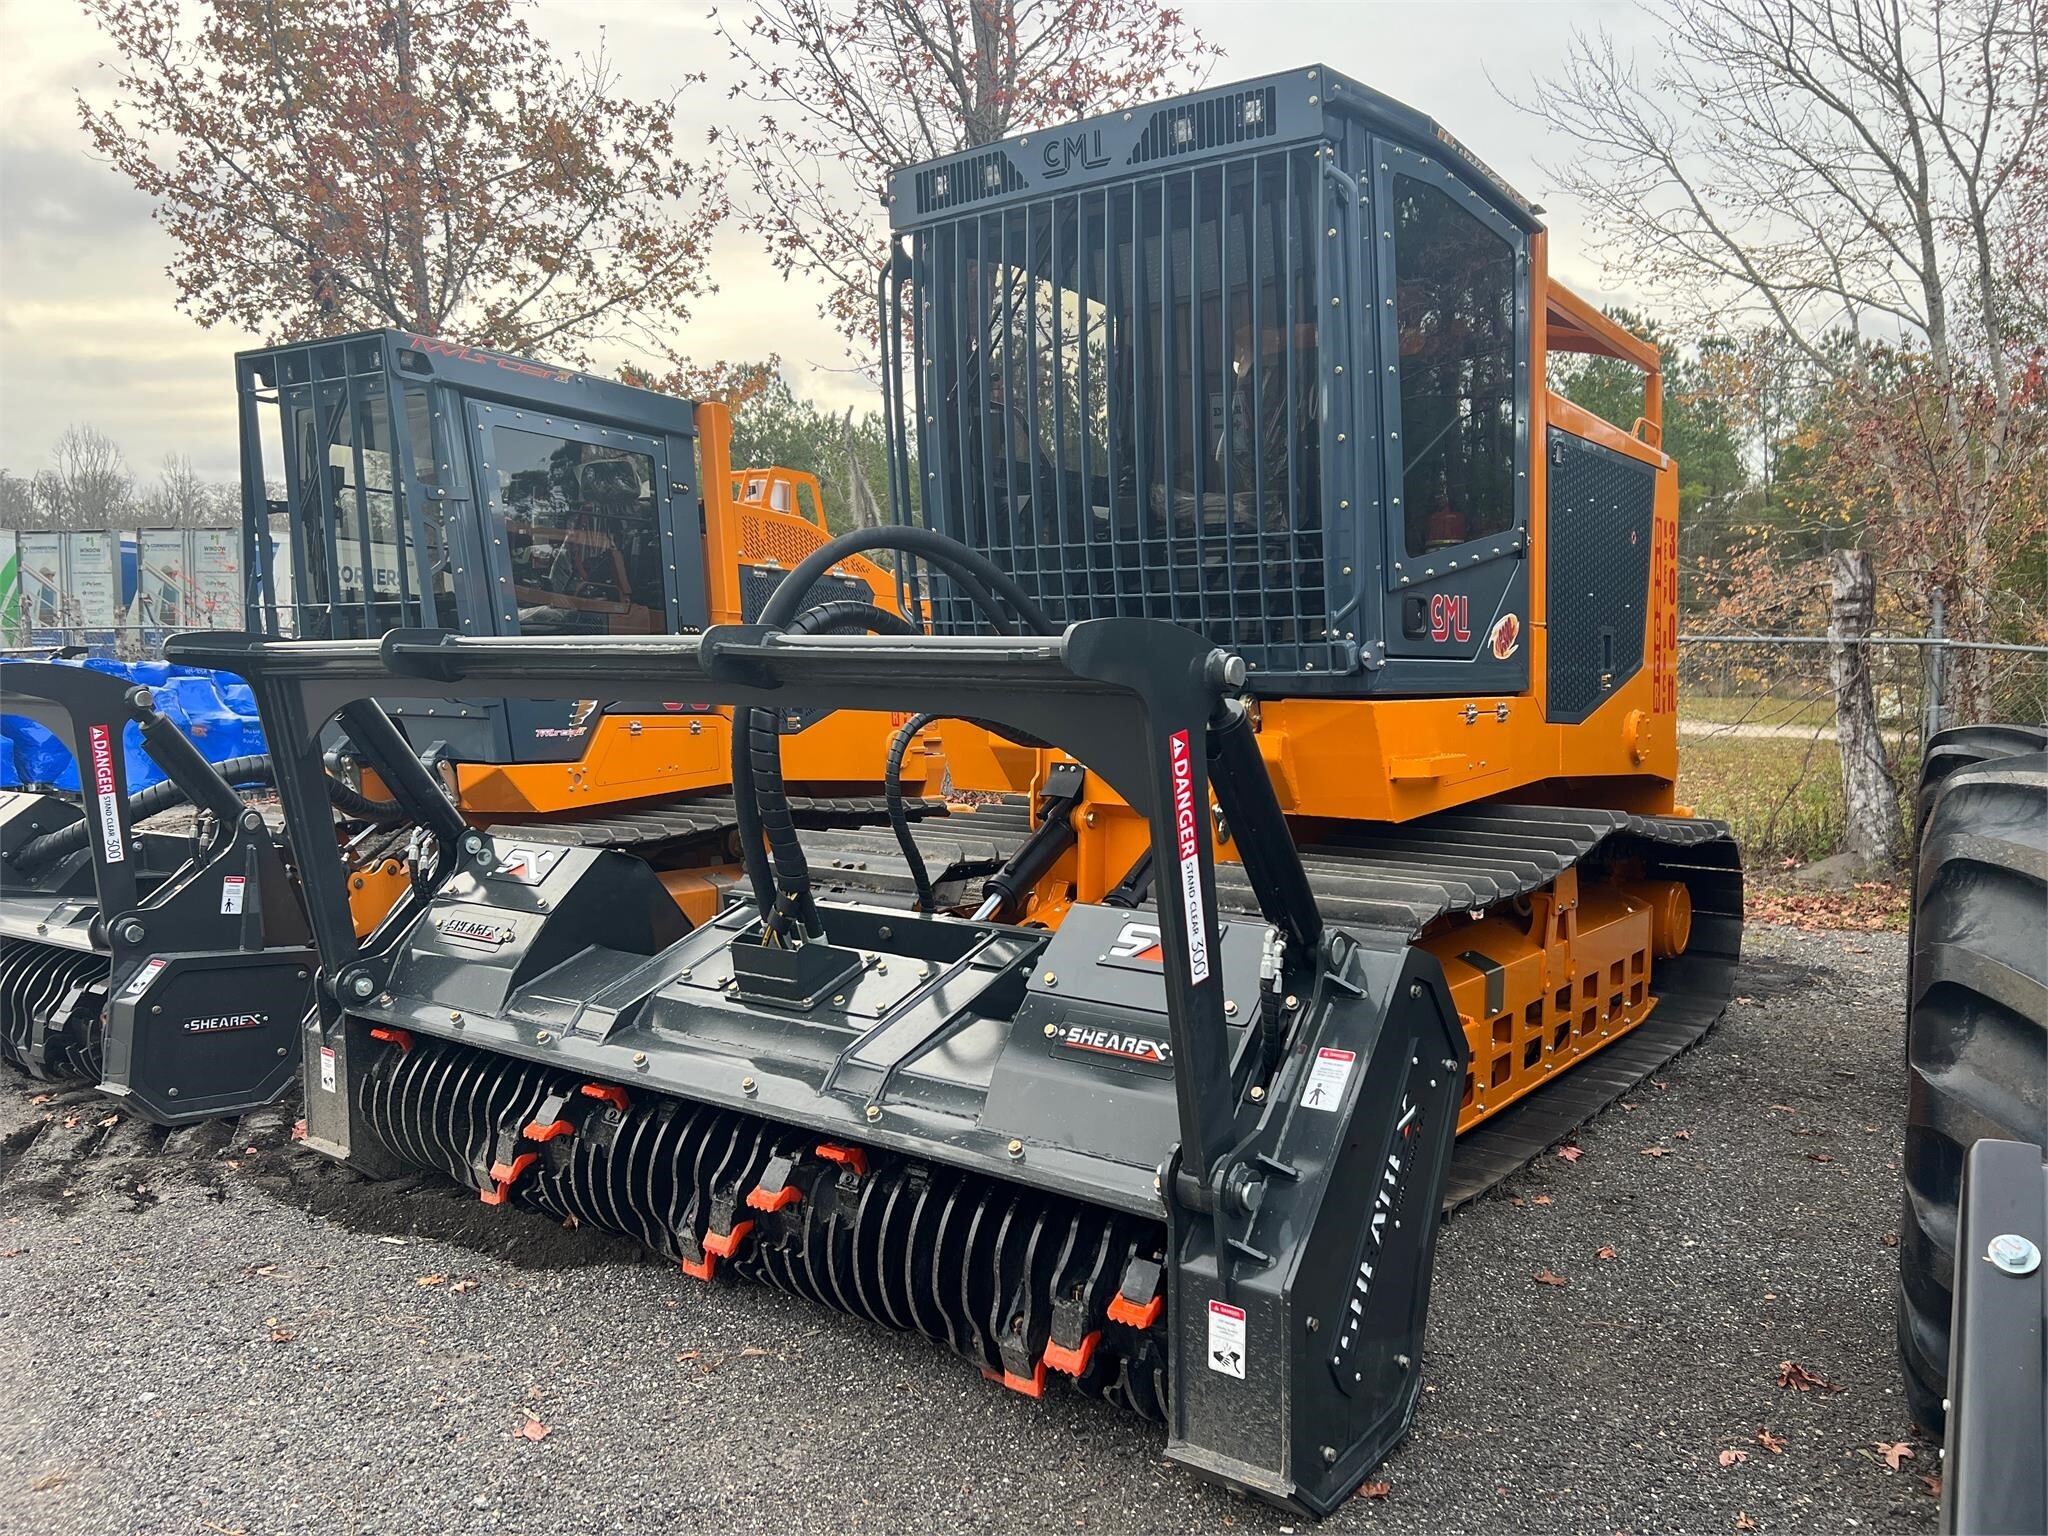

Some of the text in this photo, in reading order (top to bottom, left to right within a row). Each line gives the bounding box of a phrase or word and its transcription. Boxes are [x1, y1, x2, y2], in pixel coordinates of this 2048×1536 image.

[1668, 521, 1676, 650] 300
[1652, 517, 1663, 713] DANGER
[94, 740, 113, 794] DANGER
[103, 795, 113, 816] STAND
[1174, 758, 1197, 860] DANGER
[105, 817, 115, 837] CLEAR
[1185, 861, 1196, 899] STAND
[1189, 901, 1199, 936] CLEAR
[190, 1013, 261, 1031] SHEAREX
[1065, 1026, 1171, 1061] SHEAREX
